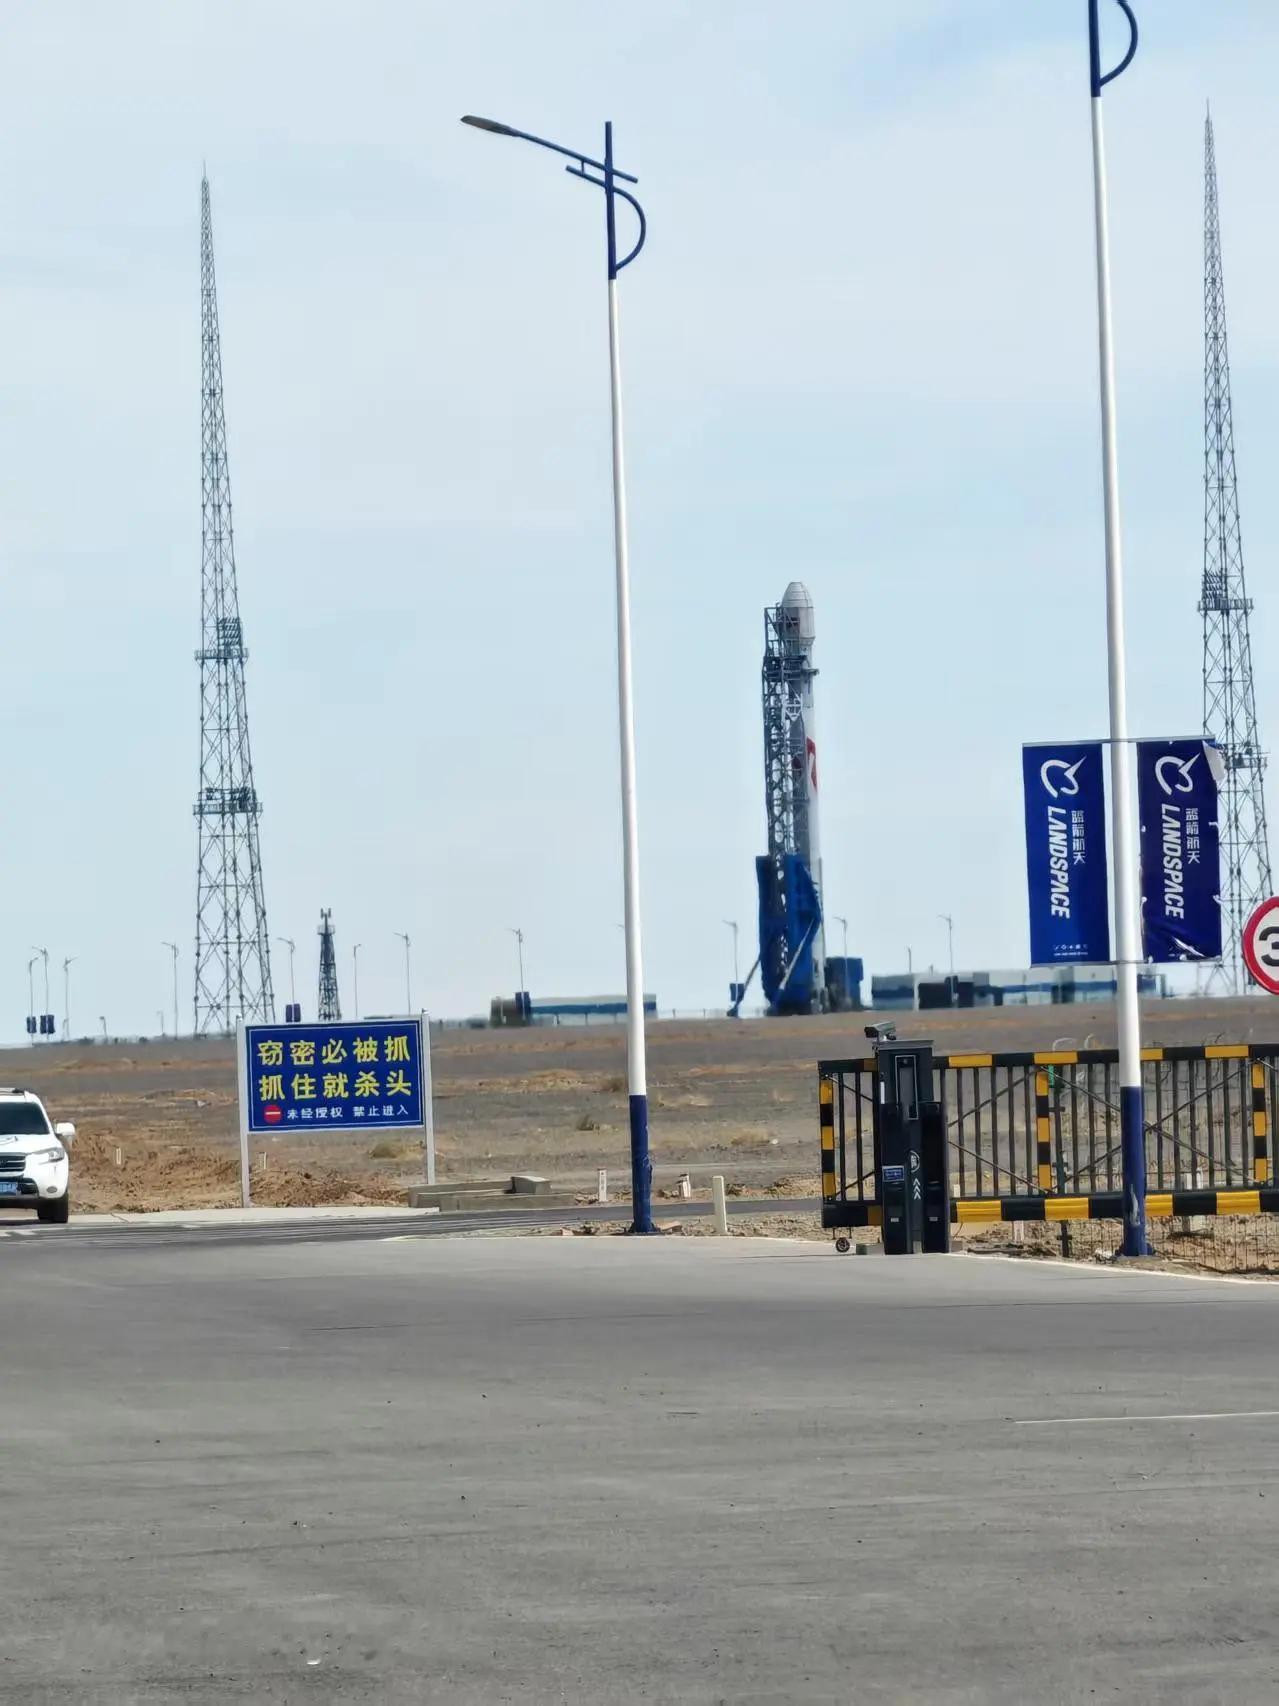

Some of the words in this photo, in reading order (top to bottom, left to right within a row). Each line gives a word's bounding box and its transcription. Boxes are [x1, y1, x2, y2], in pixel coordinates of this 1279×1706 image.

[1047, 805, 1071, 919] LANDSPACE
[1161, 803, 1185, 920] LANDSPACE
[257, 1034, 411, 1066] 窃密必被抓
[258, 1069, 412, 1102] 抓住就杀头
[286, 1106, 344, 1120] 未经授权
[352, 1104, 409, 1118] 禁止进入
